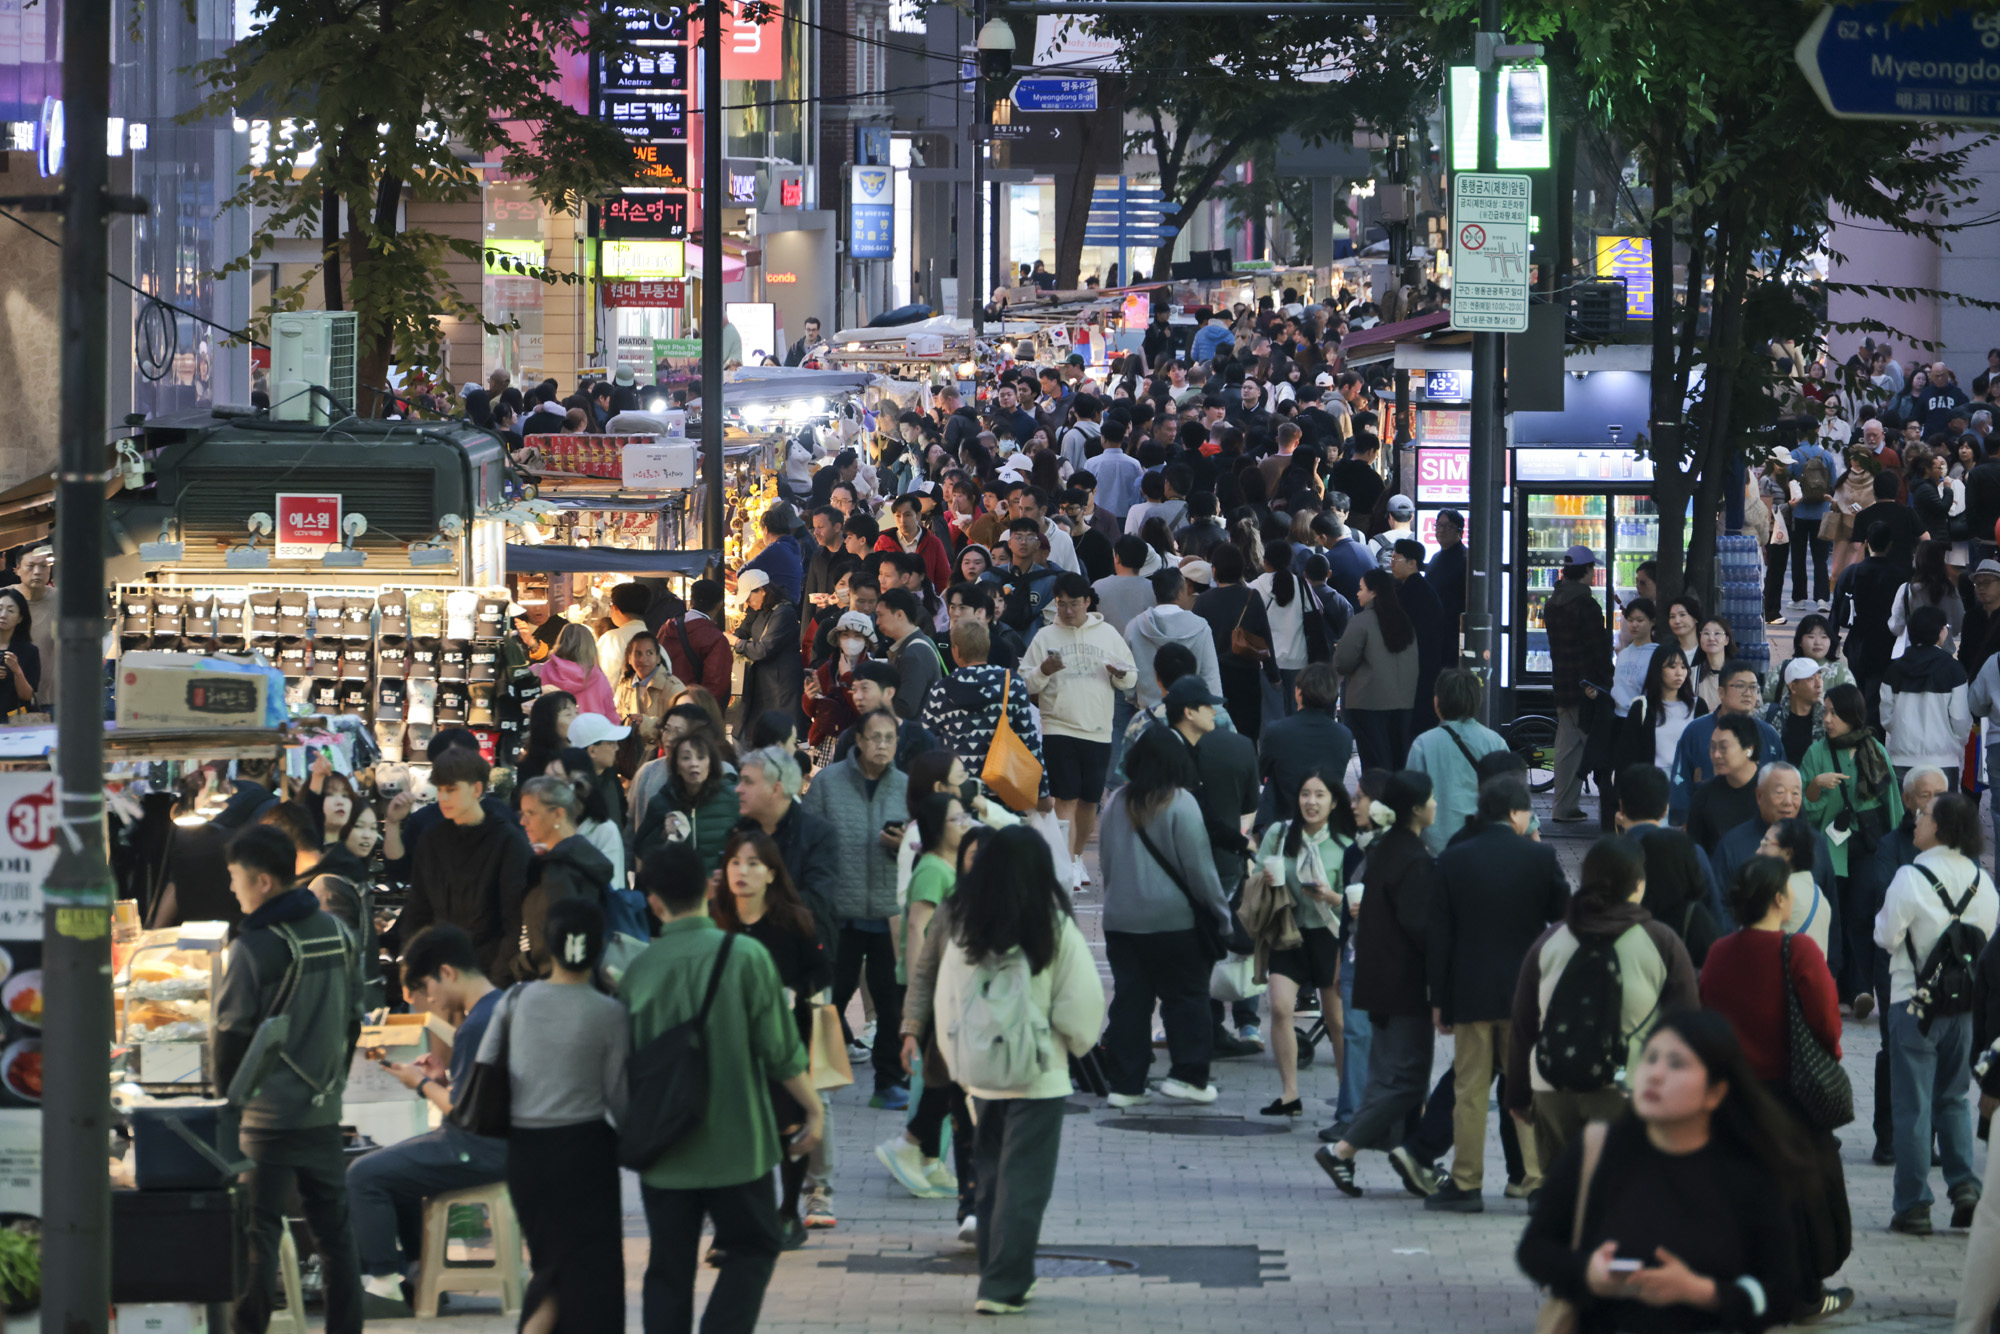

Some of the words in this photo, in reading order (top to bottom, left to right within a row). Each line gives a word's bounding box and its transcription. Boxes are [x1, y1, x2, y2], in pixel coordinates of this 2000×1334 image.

[1838, 20, 1859, 39] 62
[1872, 53, 2000, 85] Myeongdo
[617, 78, 652, 86] Alcatraz
[1033, 94, 1077, 102] Myeongdong
[1078, 94, 1094, 102] 8-gil
[613, 102, 680, 121] 보드게임
[672, 127, 681, 136] 7F
[1460, 179, 1526, 196] 통행금지(제한)알림
[609, 198, 683, 222] 약손명가
[671, 226, 682, 234] 5F
[611, 284, 636, 298] 현대
[640, 284, 679, 298] 부동산
[1429, 378, 1459, 391] 43-2
[1929, 396, 1955, 410] GAP
[1421, 458, 1468, 480] SIM
[289, 512, 330, 529] 에스원
[280, 546, 313, 555] SECOM
[384, 604, 402, 616] 서울
[444, 652, 463, 663] 최고
